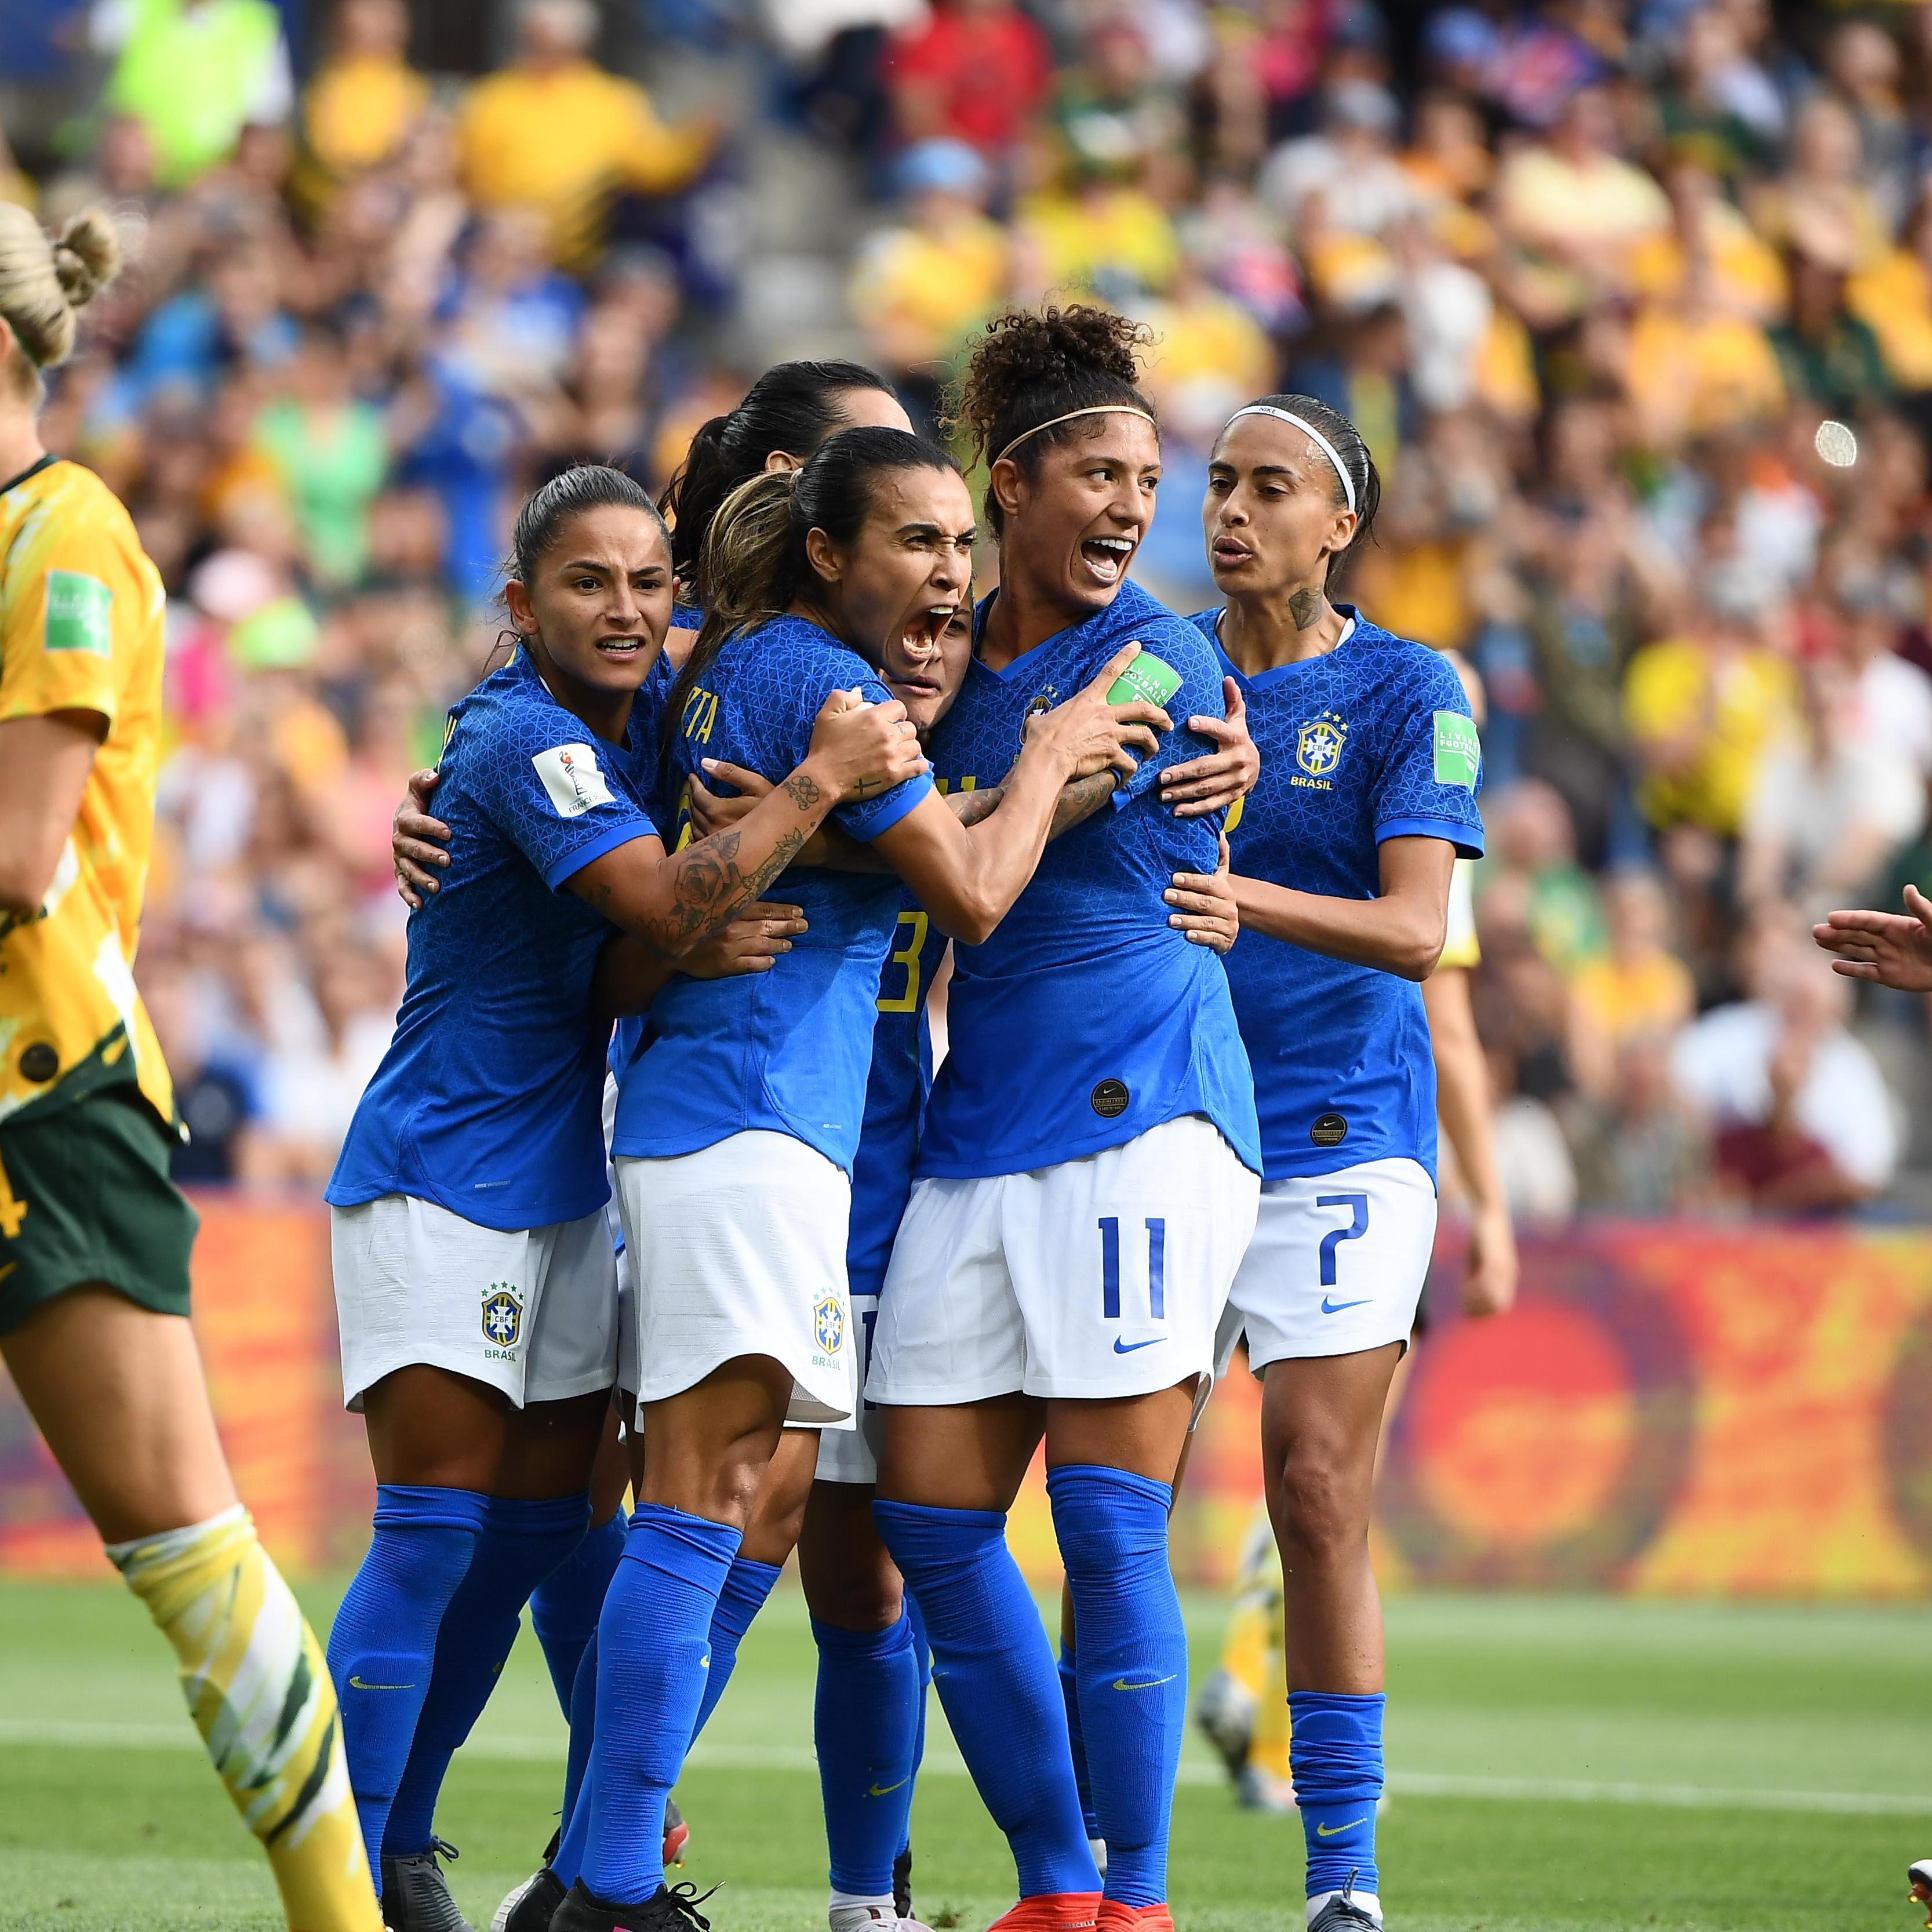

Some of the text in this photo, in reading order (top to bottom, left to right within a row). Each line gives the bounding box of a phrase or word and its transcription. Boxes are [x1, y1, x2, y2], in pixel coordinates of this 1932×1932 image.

[1124, 670, 1162, 703] OOTBALL
[1290, 776, 1333, 791] BRASIL
[1316, 1194, 1369, 1286] 7
[1098, 1217, 1165, 1320] 11
[484, 1349, 516, 1362] BRASIL
[812, 1355, 841, 1371] BRASIL
